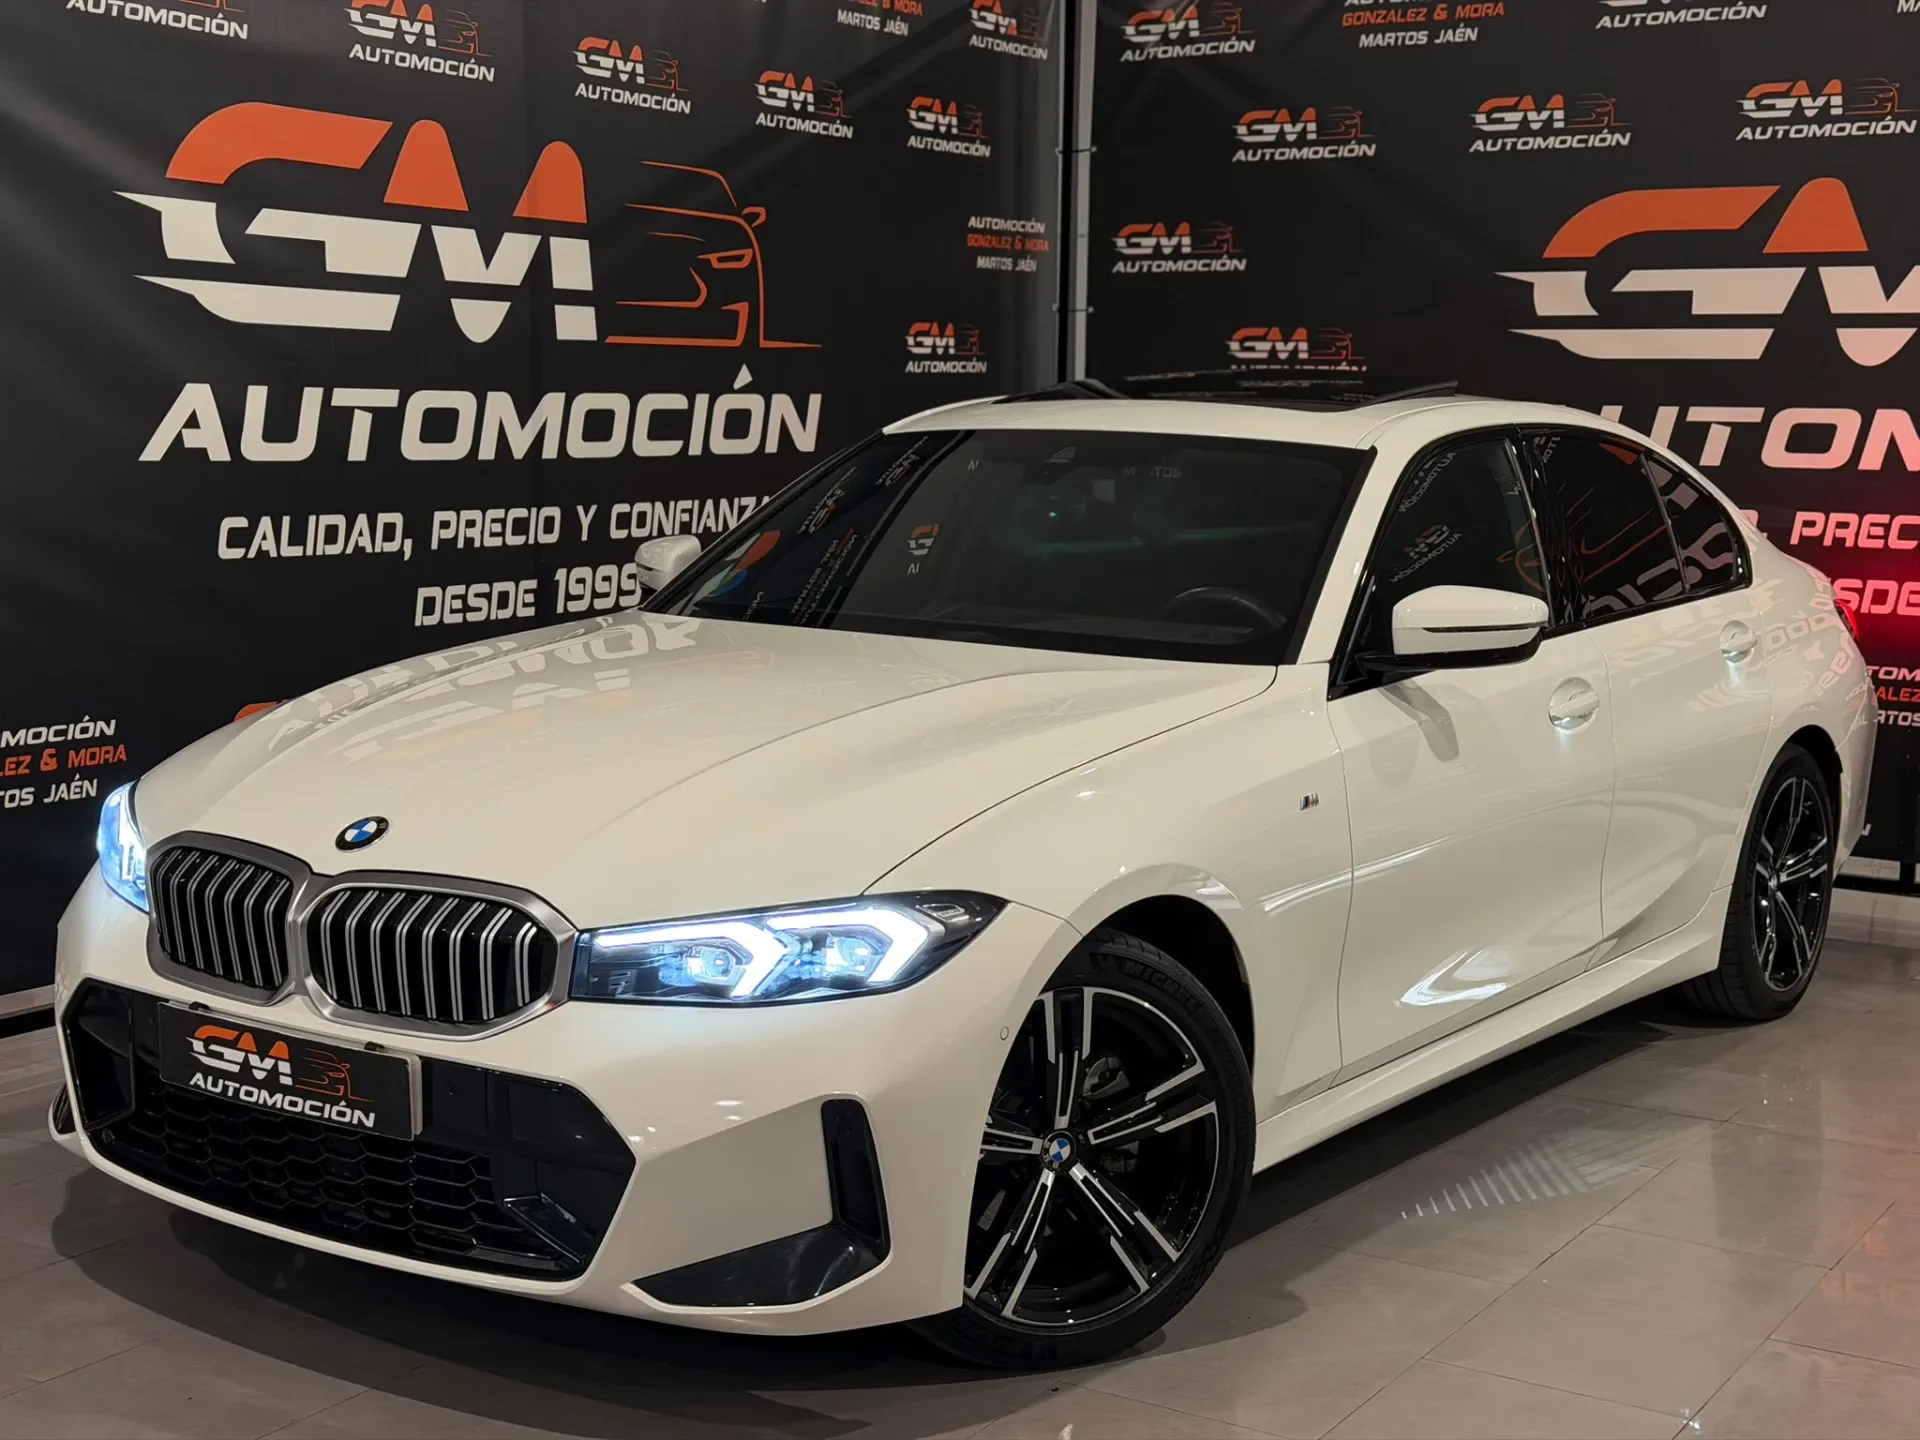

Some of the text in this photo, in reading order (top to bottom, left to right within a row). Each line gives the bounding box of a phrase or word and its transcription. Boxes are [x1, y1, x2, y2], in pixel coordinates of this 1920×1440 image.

[837, 9, 908, 36] MARTOS JAÉN
[1342, 2, 1505, 27] GONZALEZ & MORA
[1595, 1, 1767, 29] AUTOMOCIÓN
[969, 34, 1048, 60] AUTOMOCIÓN
[1119, 35, 1256, 62] AUTOMOCIÓN
[1359, 22, 1478, 48] MARTOS JAÉN
[349, 44, 495, 82] AUTOMOCIÓN
[575, 83, 691, 115] AUTOMOCIÓN
[755, 112, 853, 139] AUTOMOCIÓN
[1736, 114, 1917, 140] AUTOMOCIÓN
[907, 135, 991, 157] AUTOMOCIÓN
[1231, 140, 1377, 162] AUTOMOCIÓN
[1469, 129, 1631, 152] AUTOMOCIÓN
[967, 216, 1045, 234] AUTOMOCIÓN
[976, 255, 1013, 270] MARTOS
[1111, 254, 1247, 273] AUTOMOCIÓN
[905, 356, 987, 373] AUTOMOCIÓN
[138, 363, 822, 462] AUTOMOCIÓN
[218, 512, 413, 561] CALIDAD,
[431, 506, 561, 550] PRECIO
[576, 504, 598, 541] Y
[610, 496, 770, 539] CONFIANZ
[414, 563, 642, 626] DESDE 1999
[0, 744, 127, 777] EZ & MORA
[43, 773, 98, 803] JAÉN
[189, 1072, 375, 1128] AUTOMOCIÓN
